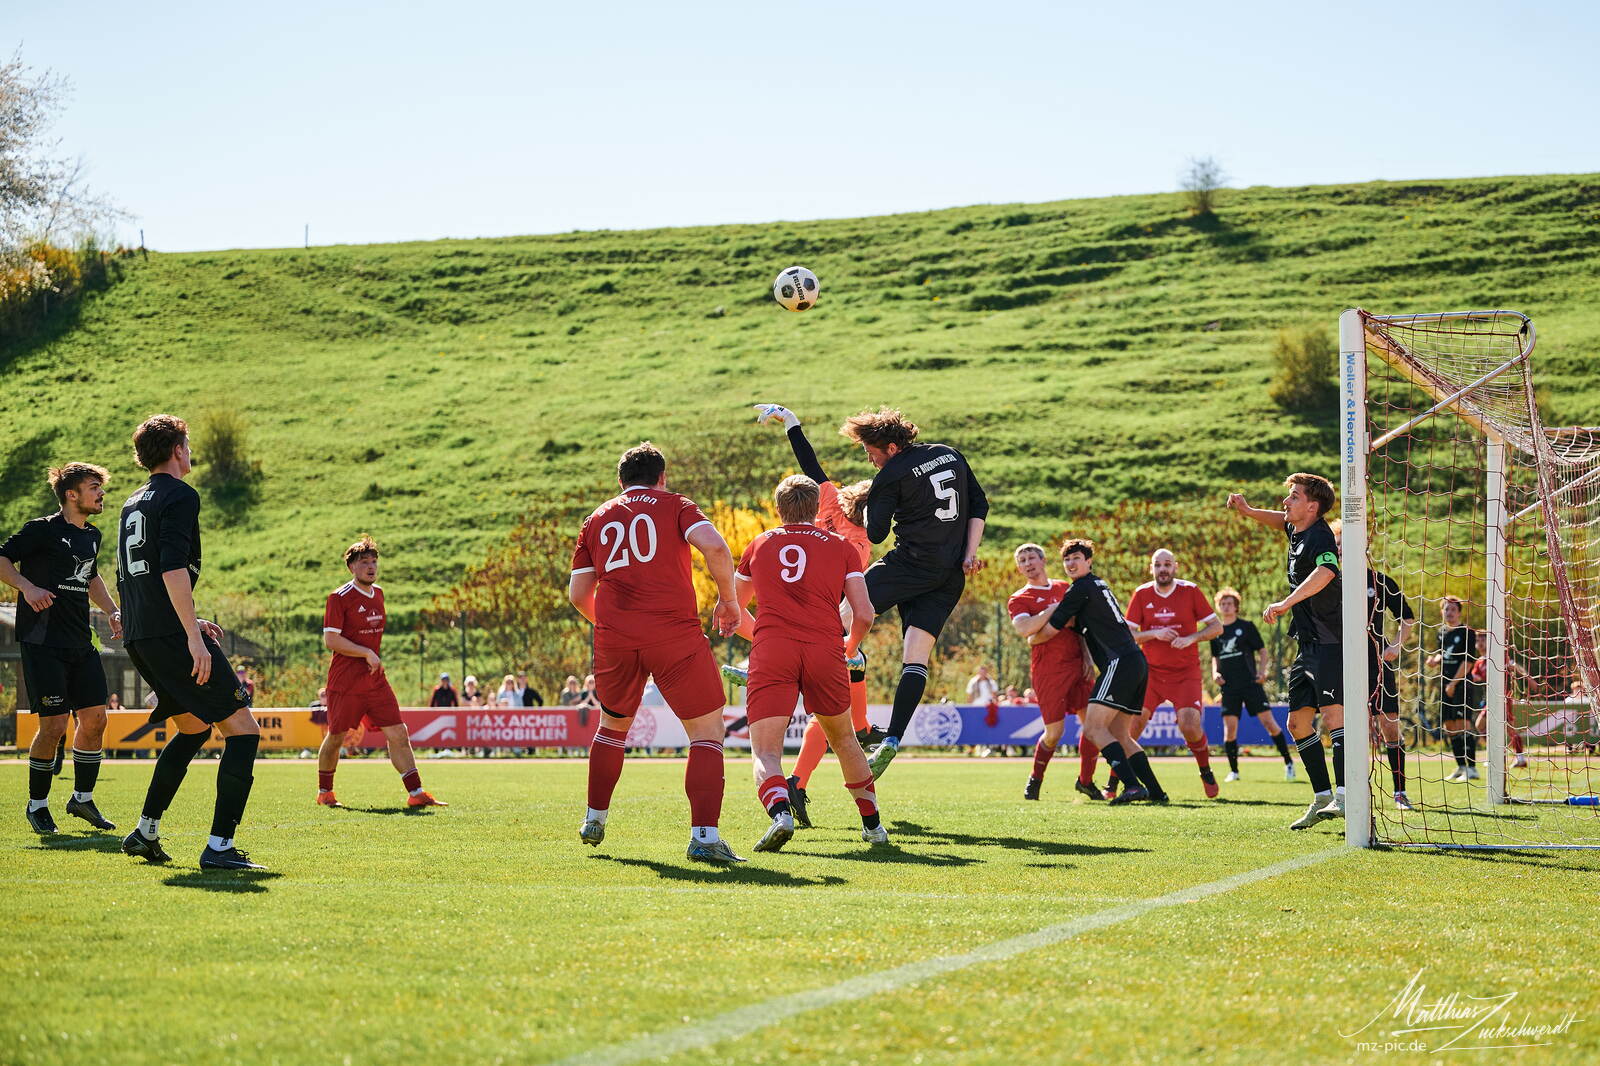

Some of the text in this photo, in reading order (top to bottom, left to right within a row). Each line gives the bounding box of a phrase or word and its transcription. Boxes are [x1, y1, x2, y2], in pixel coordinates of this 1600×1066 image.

[1346, 353, 1356, 396] Weller
[1346, 399, 1356, 409] &
[1347, 411, 1356, 463] Herden
[929, 469, 960, 522] 5
[600, 513, 658, 573] 20
[778, 544, 807, 583] 9
[466, 714, 567, 727] MAX AICHER
[466, 728, 568, 741] IMMOBILIEN
